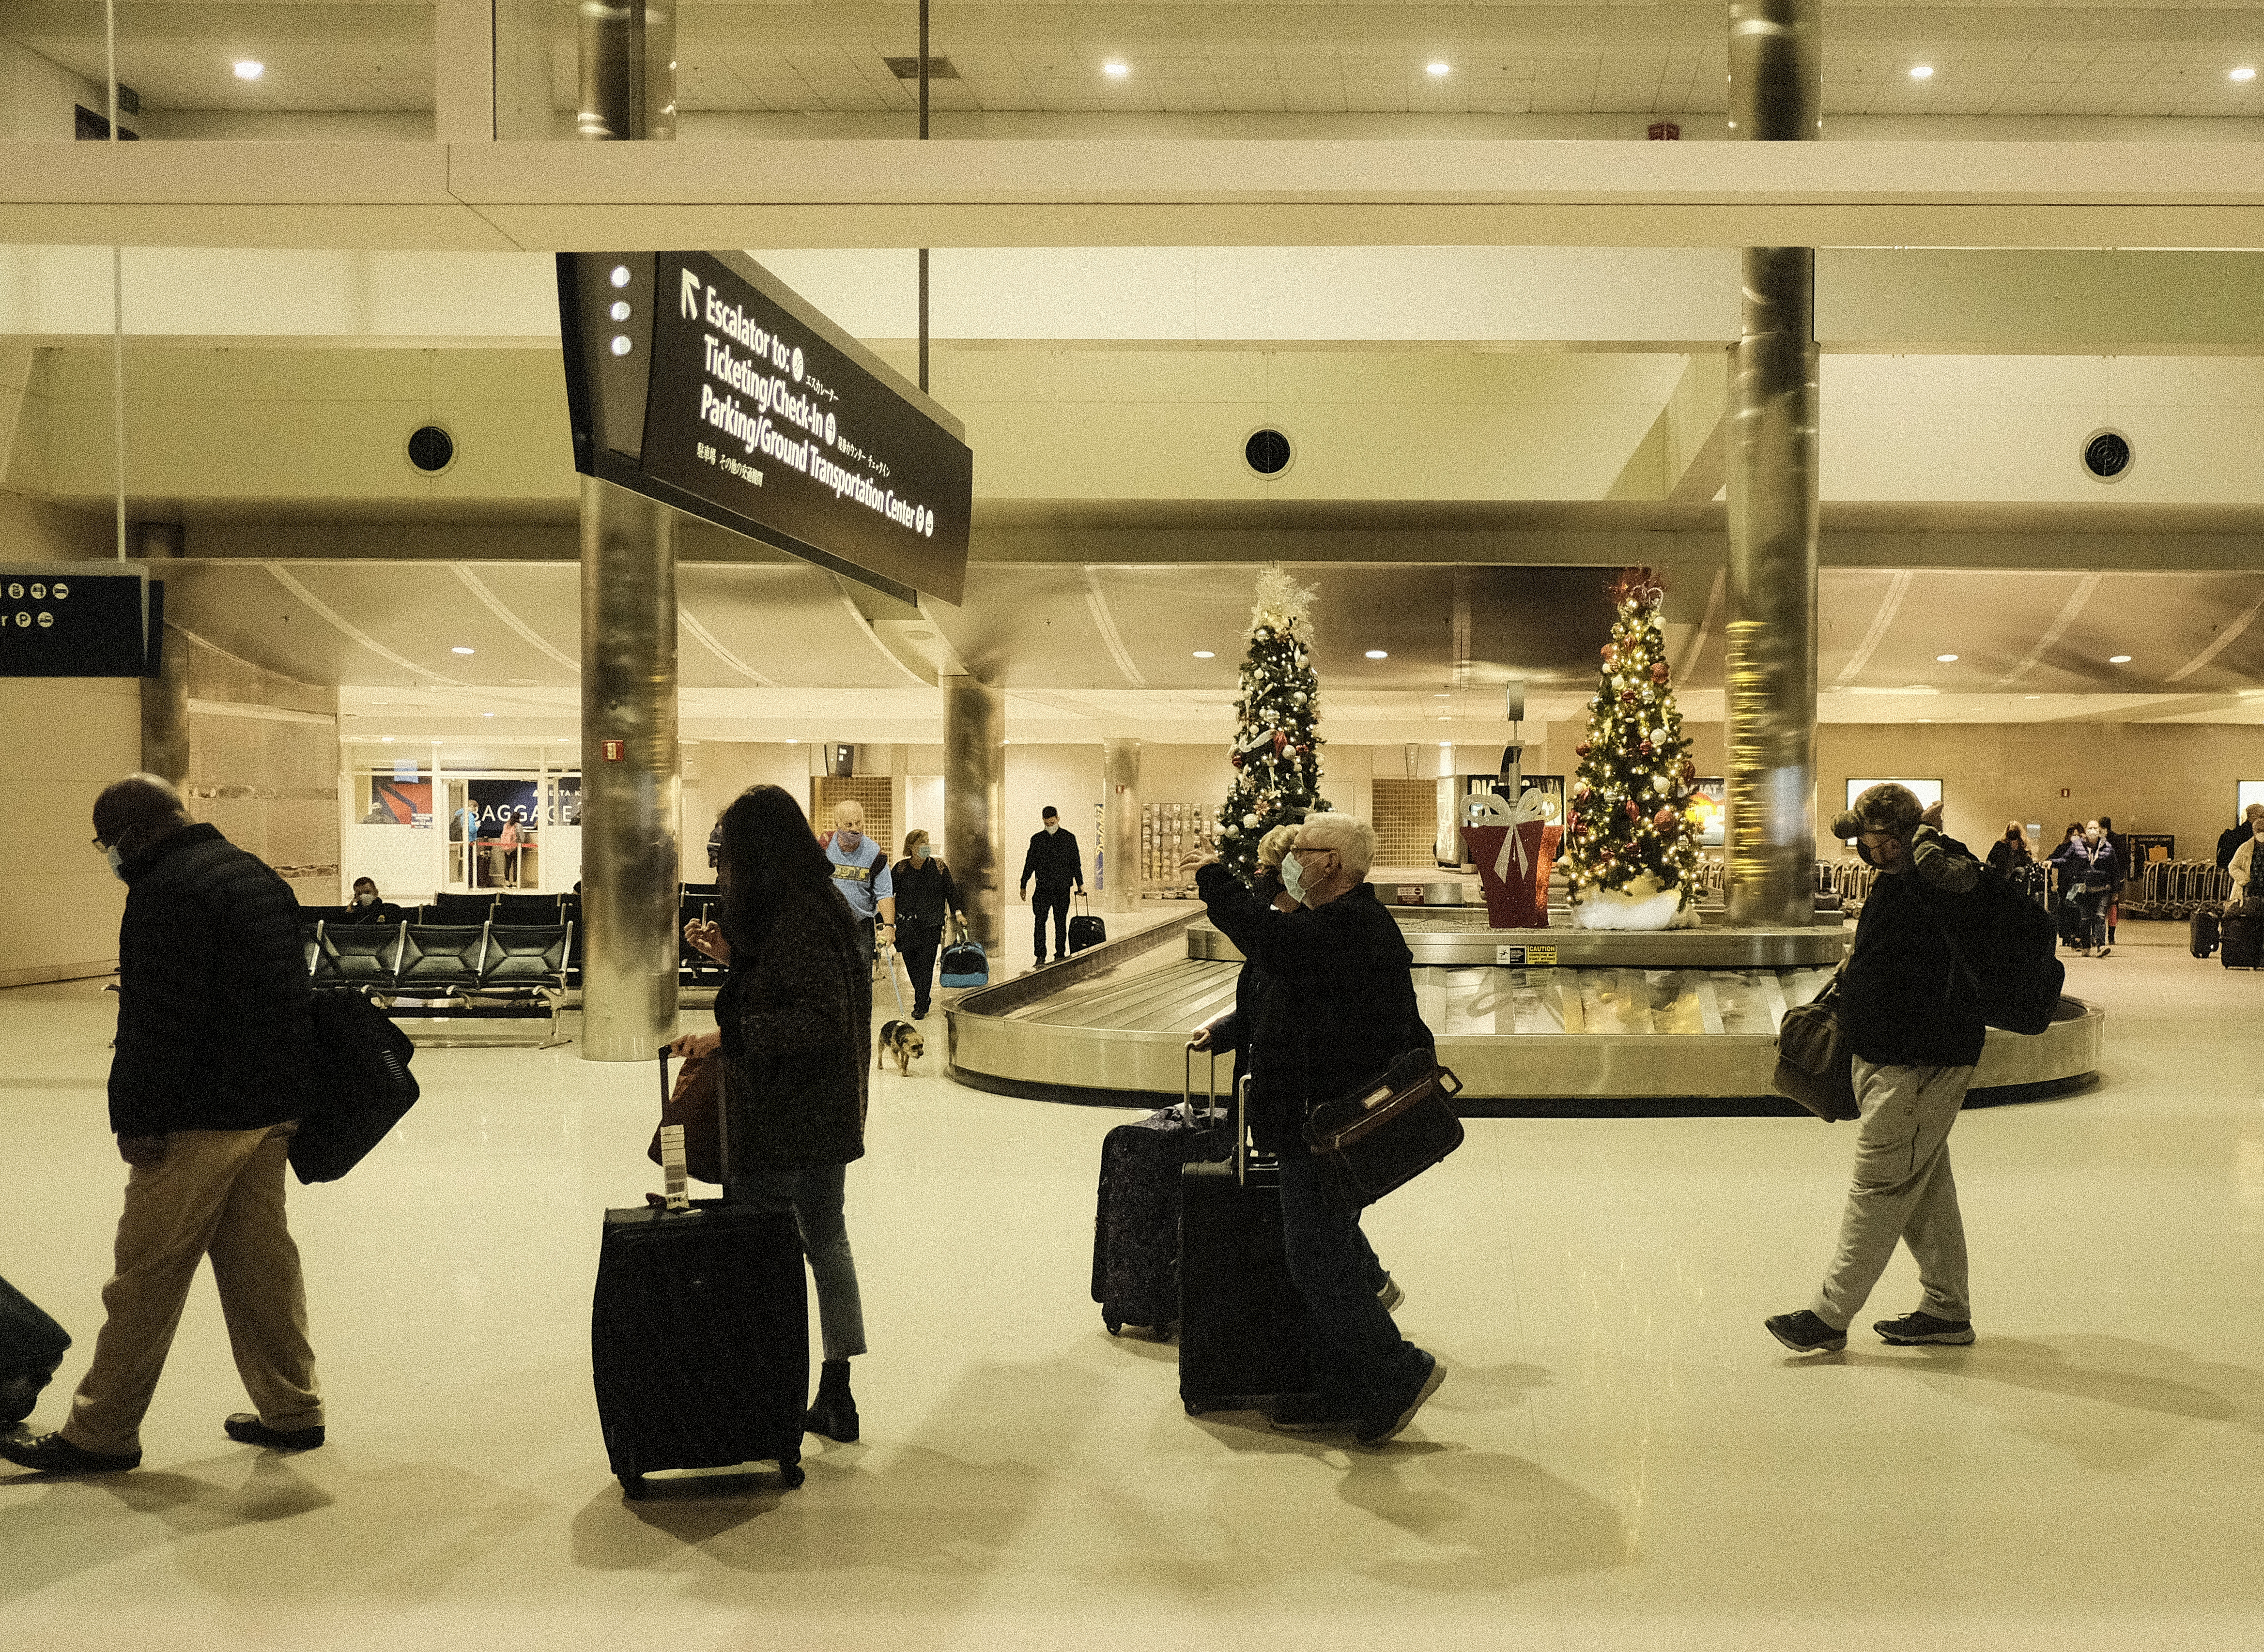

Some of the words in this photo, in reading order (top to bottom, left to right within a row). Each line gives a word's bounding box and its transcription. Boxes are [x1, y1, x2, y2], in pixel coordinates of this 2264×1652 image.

[706, 285, 770, 358] Escalator
[772, 335, 790, 372] to:
[704, 334, 823, 437] Ticketing/Check-In
[805, 375, 839, 402] エスカレーター
[702, 384, 808, 472] Parking/Ground
[810, 445, 884, 512] Transportation
[886, 489, 915, 528] Center
[868, 455, 890, 477] チェックイン
